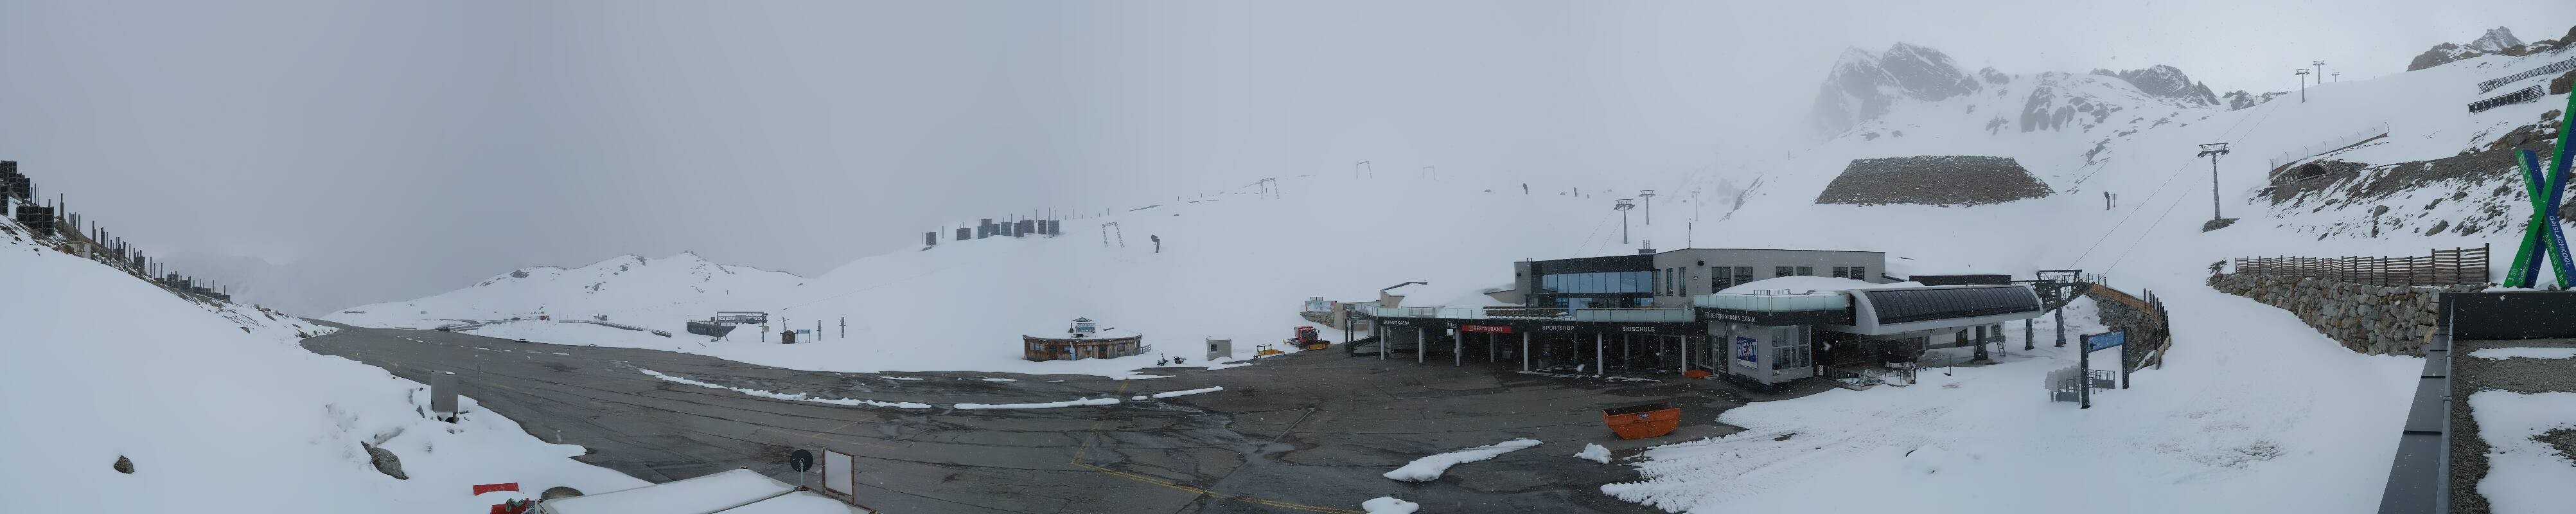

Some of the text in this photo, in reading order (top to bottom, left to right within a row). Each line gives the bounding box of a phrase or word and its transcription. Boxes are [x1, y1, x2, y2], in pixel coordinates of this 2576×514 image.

[2519, 154, 2530, 183] BIG 3
[2549, 215, 2571, 266] GAISLACHKOGL
[1737, 342, 1757, 357] RENT
